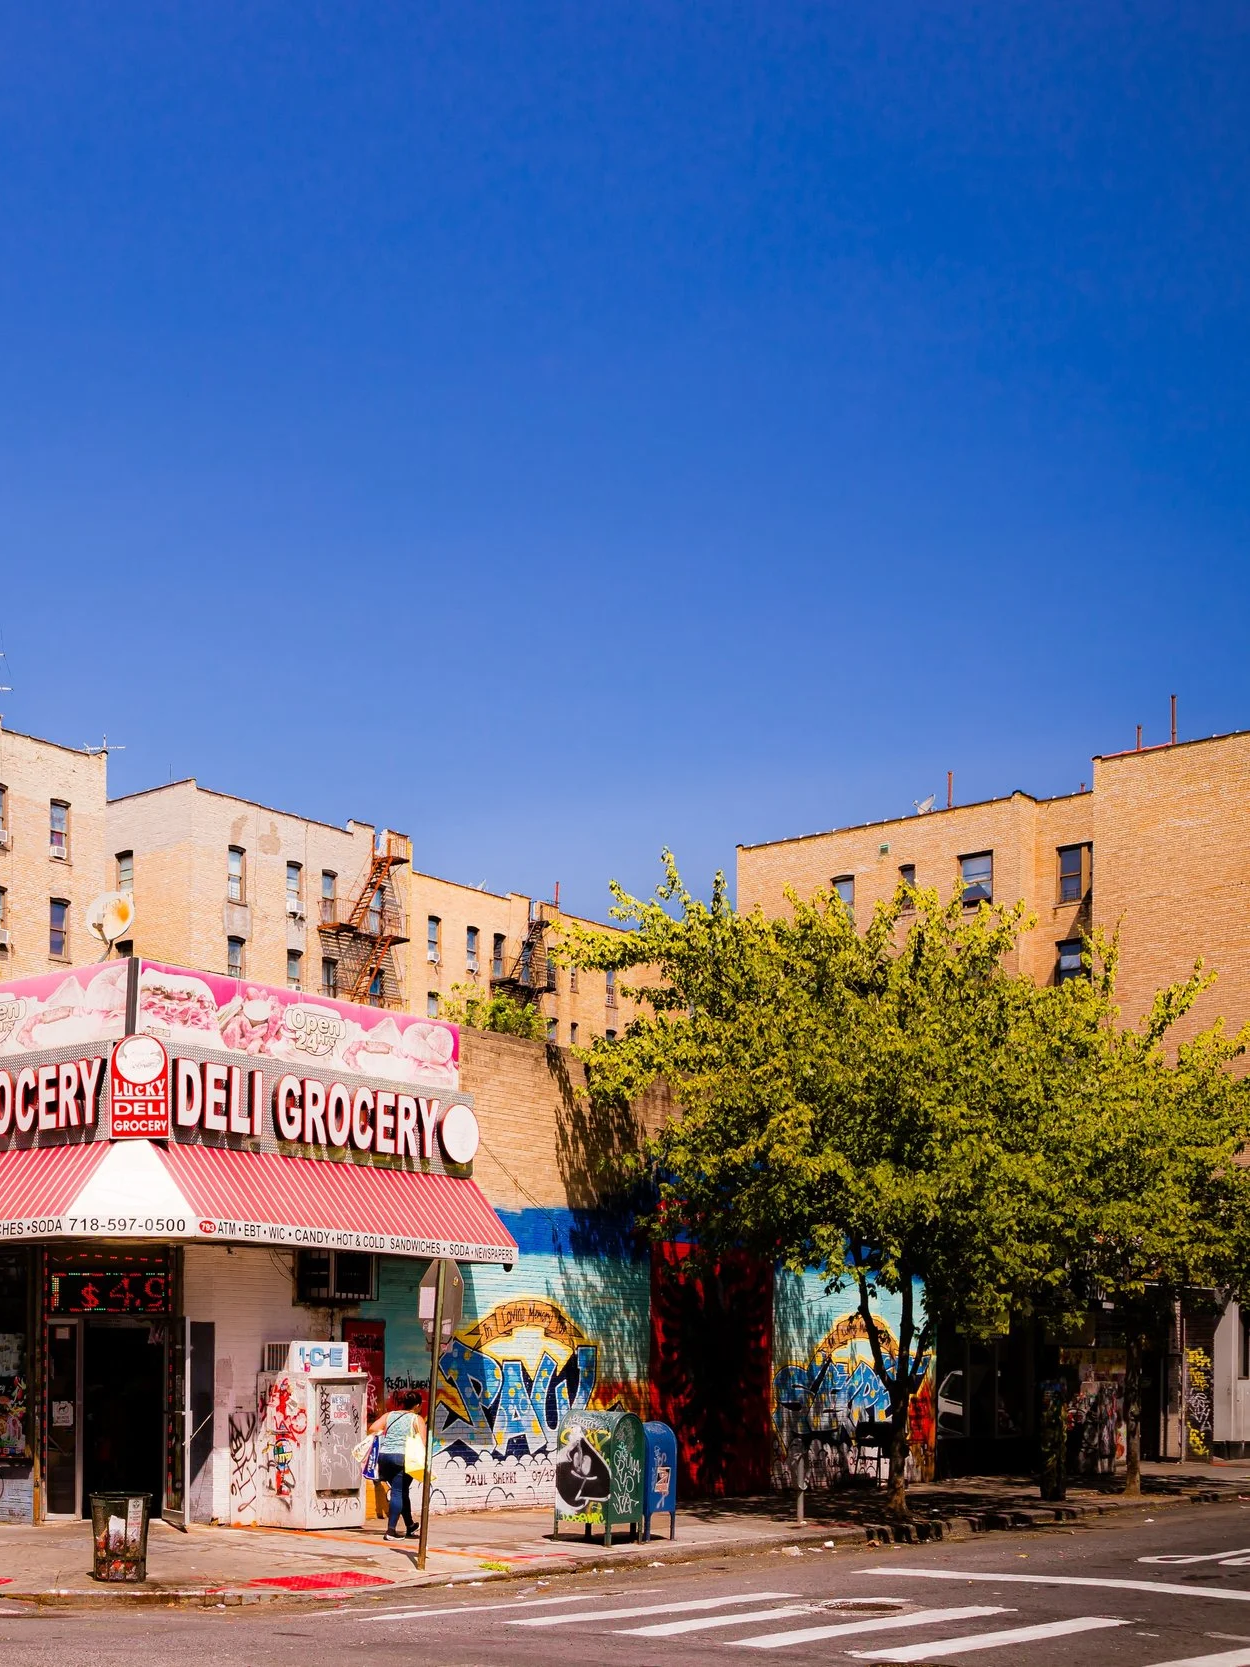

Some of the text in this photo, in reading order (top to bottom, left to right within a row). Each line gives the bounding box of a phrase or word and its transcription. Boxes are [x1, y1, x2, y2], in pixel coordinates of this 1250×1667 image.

[114, 1102, 165, 1115] DELI
[174, 1057, 440, 1158] DELI GROCERY
[113, 1120, 167, 1132] GROCERY
[31, 1218, 63, 1234] SODA
[69, 1218, 186, 1232] 718-597-0500
[200, 1222, 514, 1261] 793 ATM EBT WIC CANDY HOT & COLD SANDWICHES SODA NEWSPAPERS
